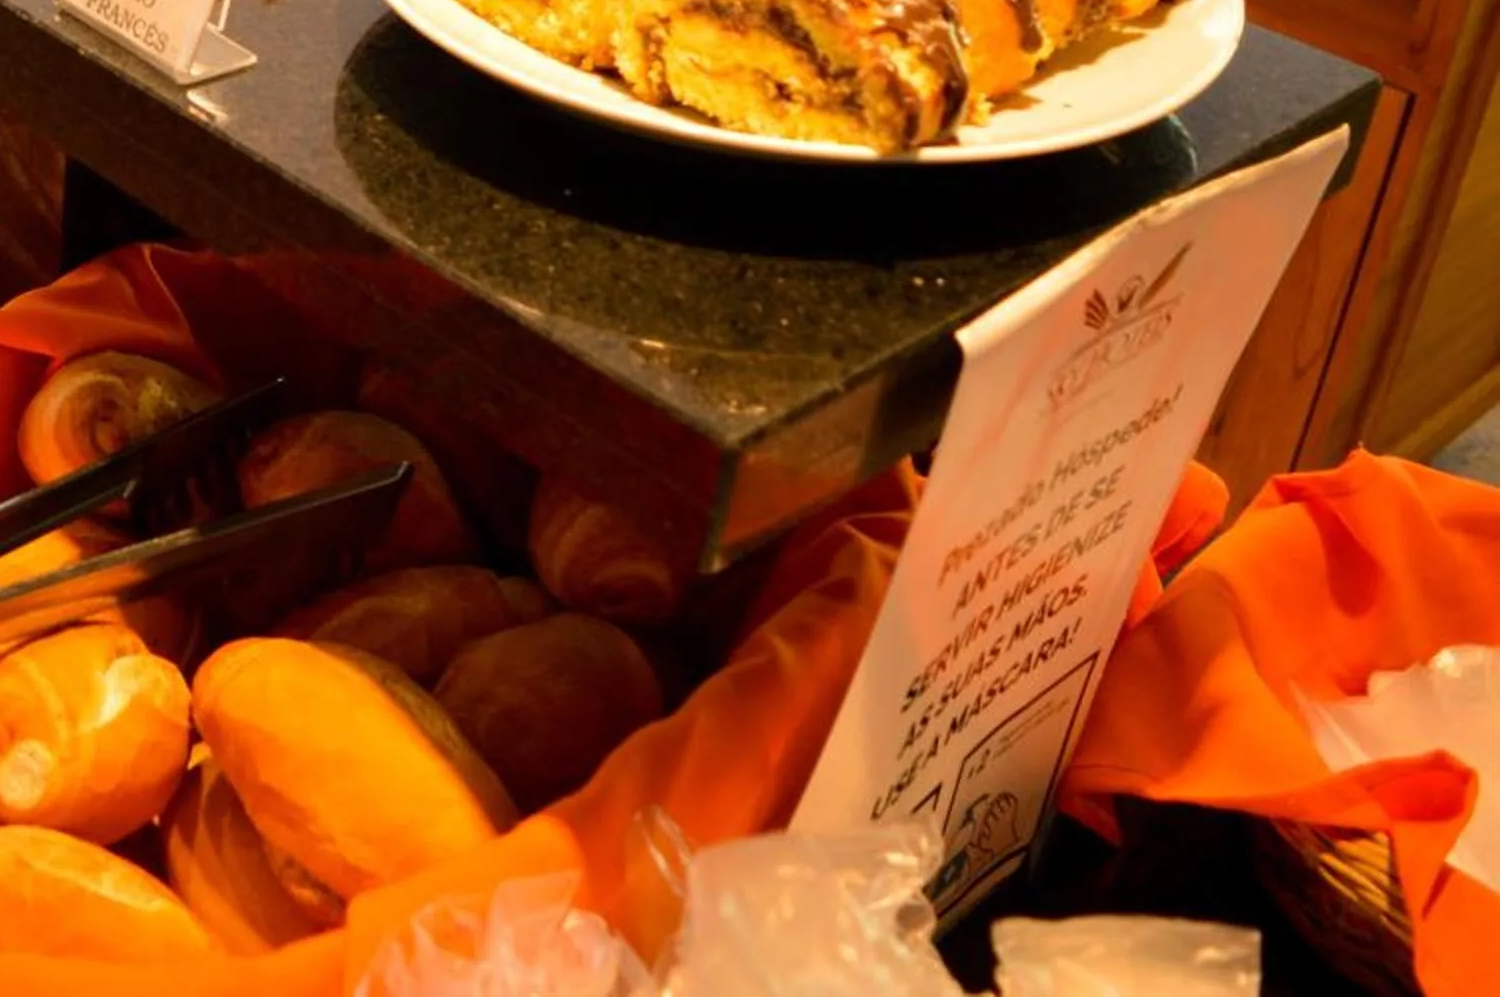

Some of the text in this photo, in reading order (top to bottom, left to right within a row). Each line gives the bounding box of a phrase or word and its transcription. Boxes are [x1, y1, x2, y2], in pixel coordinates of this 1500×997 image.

[901, 500, 1133, 714] SERVIR HIGIENIZE
[952, 464, 1126, 620] ANTES DE SE
[897, 703, 935, 760] AS
[934, 635, 1004, 717] SUAS
[871, 753, 923, 821] USE
[921, 735, 940, 769] A
